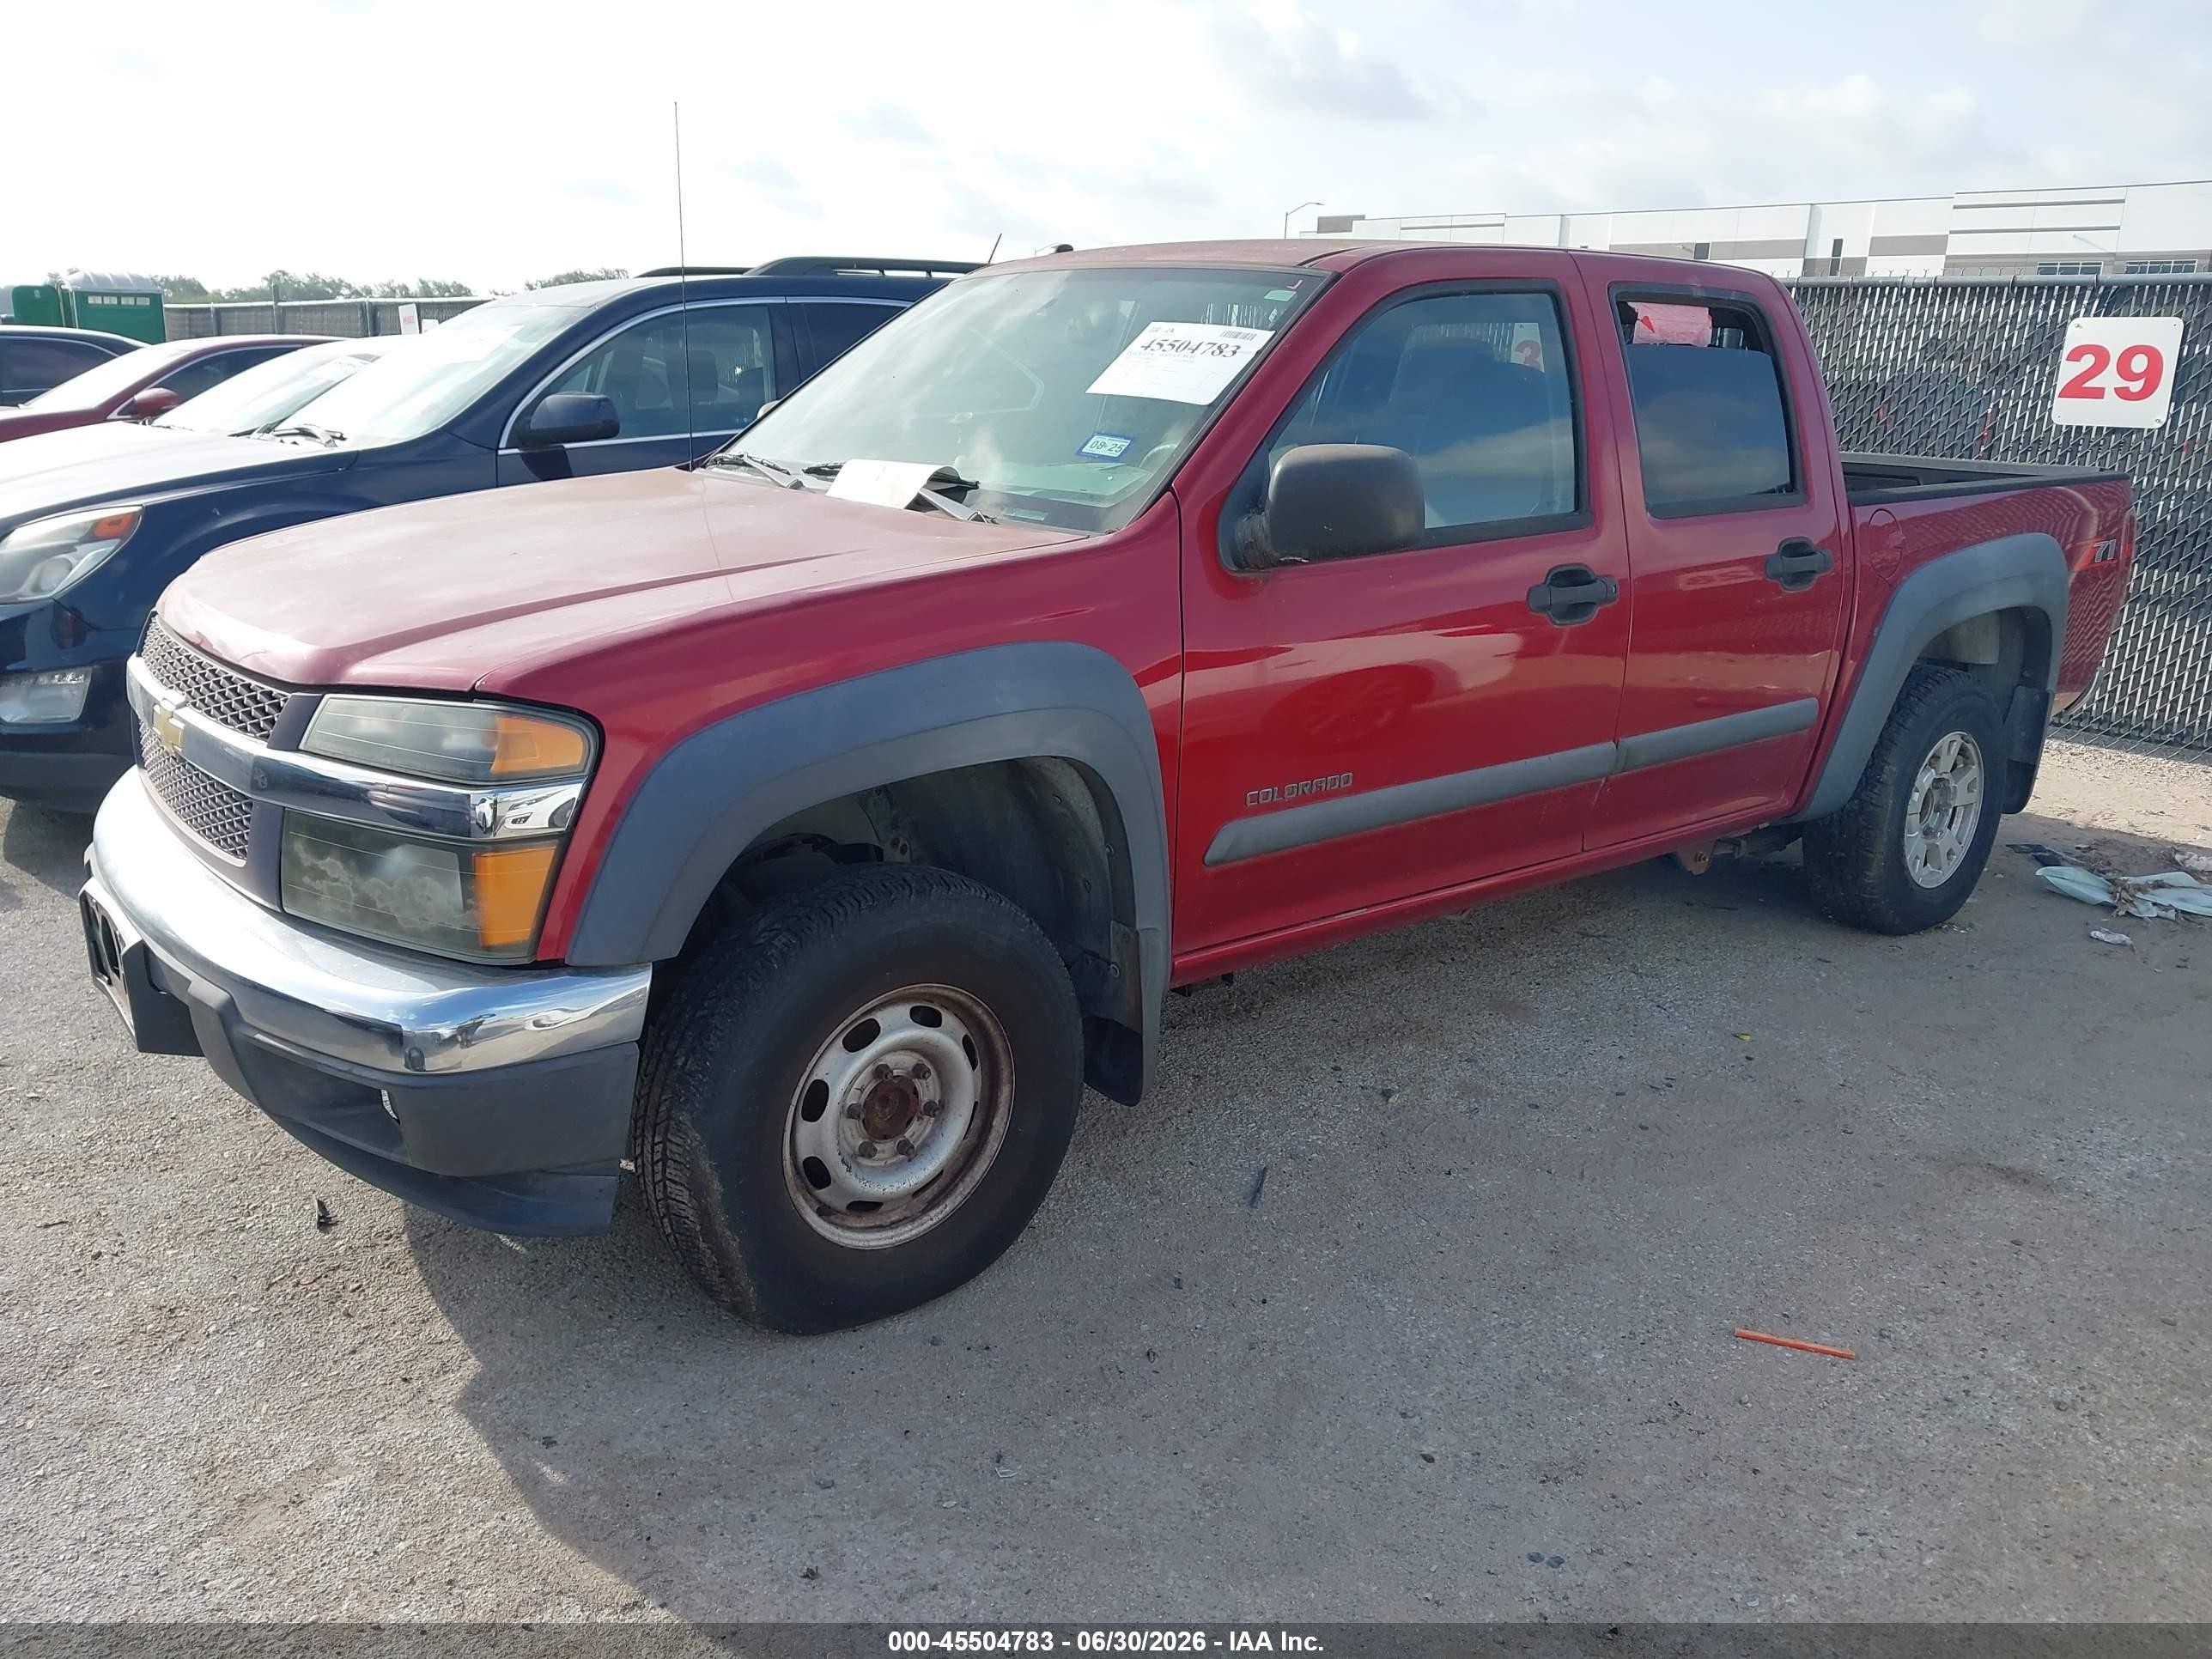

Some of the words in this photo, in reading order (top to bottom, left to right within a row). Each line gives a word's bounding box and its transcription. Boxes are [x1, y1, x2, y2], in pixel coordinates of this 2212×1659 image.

[1140, 337, 1241, 358] 45504783
[2057, 343, 2165, 402] 29
[1108, 443, 1126, 453] 25
[1246, 772, 1353, 807] COLORADO
